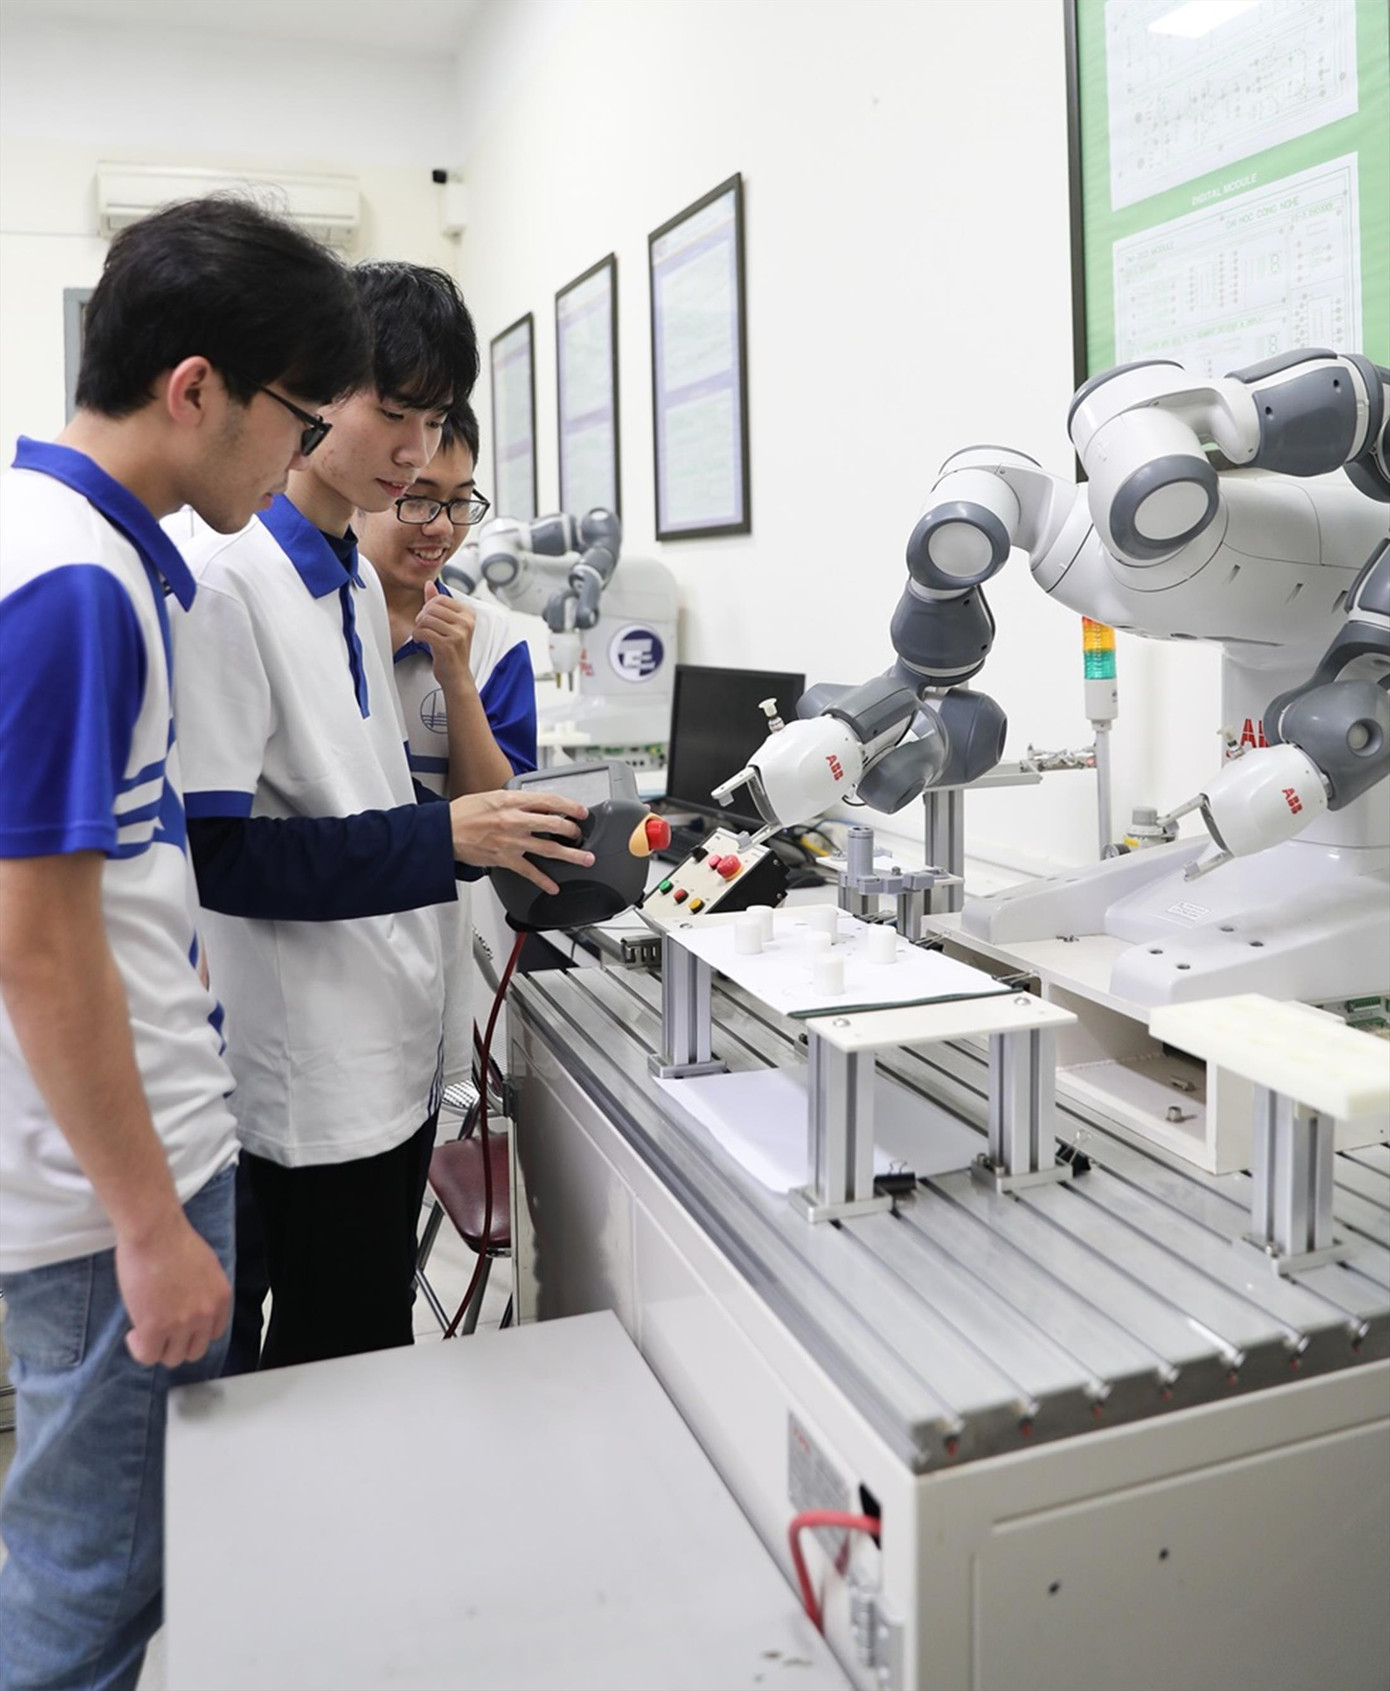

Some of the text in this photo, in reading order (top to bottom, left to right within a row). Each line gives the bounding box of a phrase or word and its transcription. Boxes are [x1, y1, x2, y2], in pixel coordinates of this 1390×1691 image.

[1192, 174, 1258, 206] DIGITAL MODULE
[825, 754, 844, 781] ABB
[1282, 788, 1303, 814] ABB
